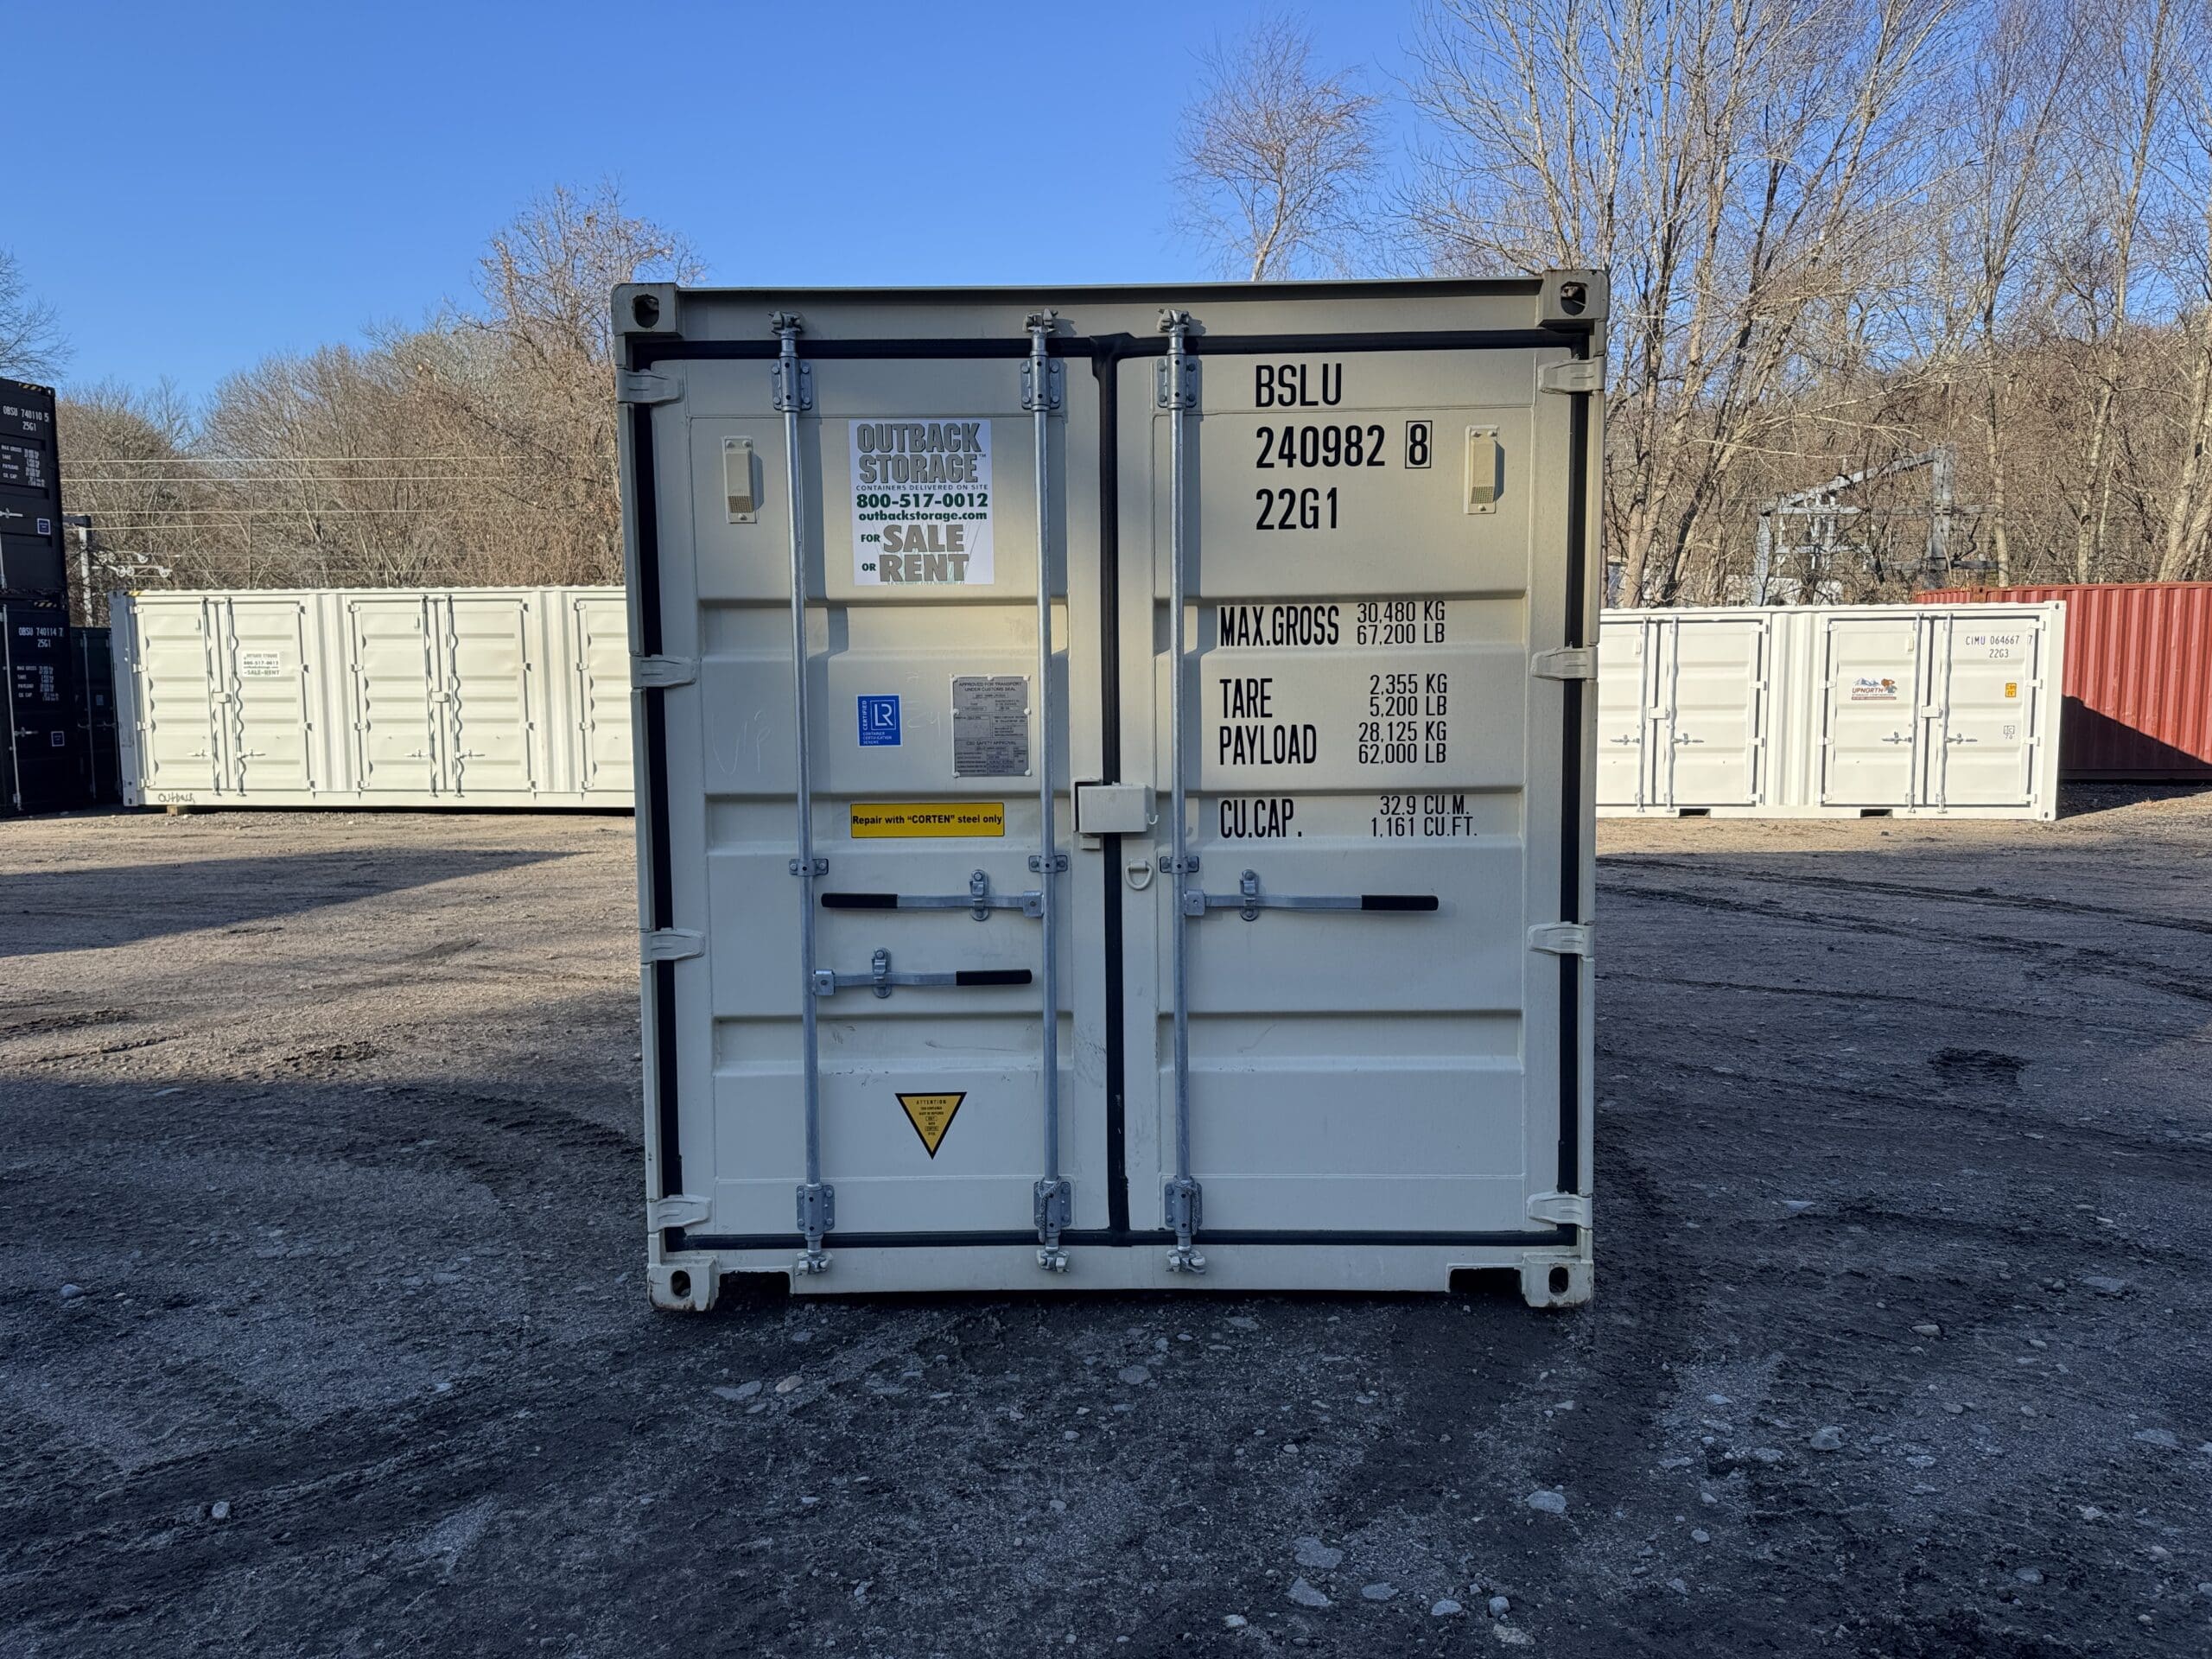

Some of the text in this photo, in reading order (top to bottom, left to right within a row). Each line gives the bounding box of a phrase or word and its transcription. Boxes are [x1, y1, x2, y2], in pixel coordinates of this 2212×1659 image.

[1255, 363, 1342, 408] BSLU
[43, 412, 49, 423] 5
[856, 423, 982, 453] OUTBACK
[1255, 423, 1428, 468] 240982 8
[858, 454, 978, 483] STORAGE
[856, 493, 988, 508] 800-517-0012
[1255, 487, 1338, 531] 22G1
[858, 510, 987, 522] outbackstorage.com
[861, 524, 964, 553] FOR SALE
[879, 554, 969, 582] RENT
[1219, 601, 1446, 647] MAX.GROSS 30,480 KG
[1357, 623, 1446, 645] 67,200 LB
[1965, 636, 1986, 645] CIMU
[1990, 635, 2020, 645] 064667
[1989, 648, 2009, 658] 22G3
[1219, 674, 1447, 719] TARE 2,355 KG
[1370, 696, 1447, 718] 5,200 LB
[874, 703, 893, 726] LR
[1219, 721, 1446, 765] PAYLOAD 28,125 KG
[1358, 743, 1446, 765] 62,000 LB
[852, 816, 881, 825] Repair
[885, 815, 905, 824] with
[957, 814, 981, 823] steel
[982, 814, 1002, 825] only
[1219, 795, 1470, 838] CU.CAP. 32.9 CU.M.
[1371, 817, 1478, 838] 1,161 CU.FT.
